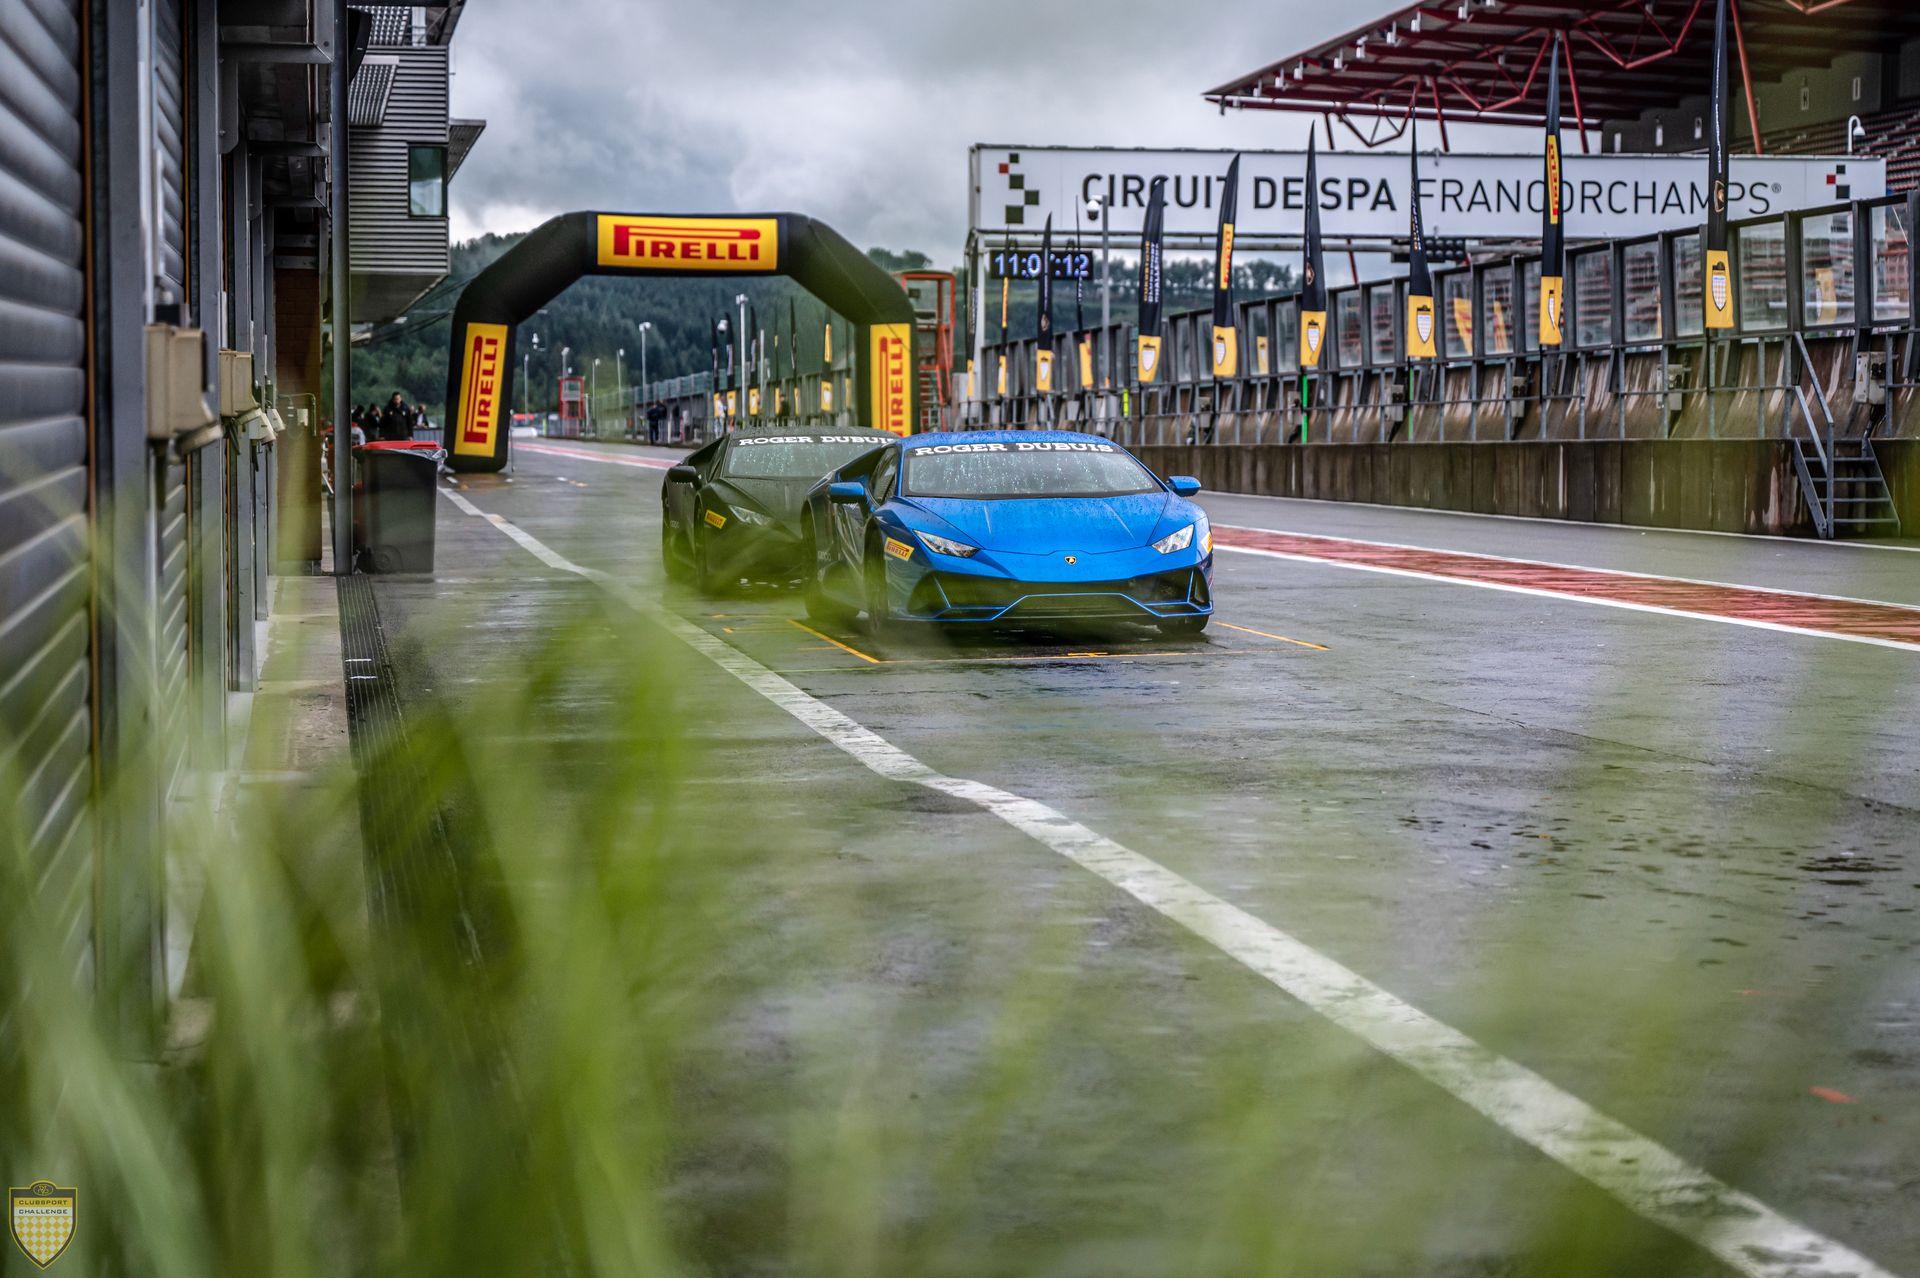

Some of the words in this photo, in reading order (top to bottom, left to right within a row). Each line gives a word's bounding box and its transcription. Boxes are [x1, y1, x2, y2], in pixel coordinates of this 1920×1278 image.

[1254, 176, 1304, 210] DE
[1320, 177, 1397, 212] SPA
[613, 224, 761, 261] PIRELLI
[994, 253, 1089, 277] 11:0:12
[463, 335, 498, 444] PIRELLI
[738, 436, 814, 446] ROGER
[915, 443, 1008, 456] ROGER
[1015, 442, 1114, 453] DUBUIS
